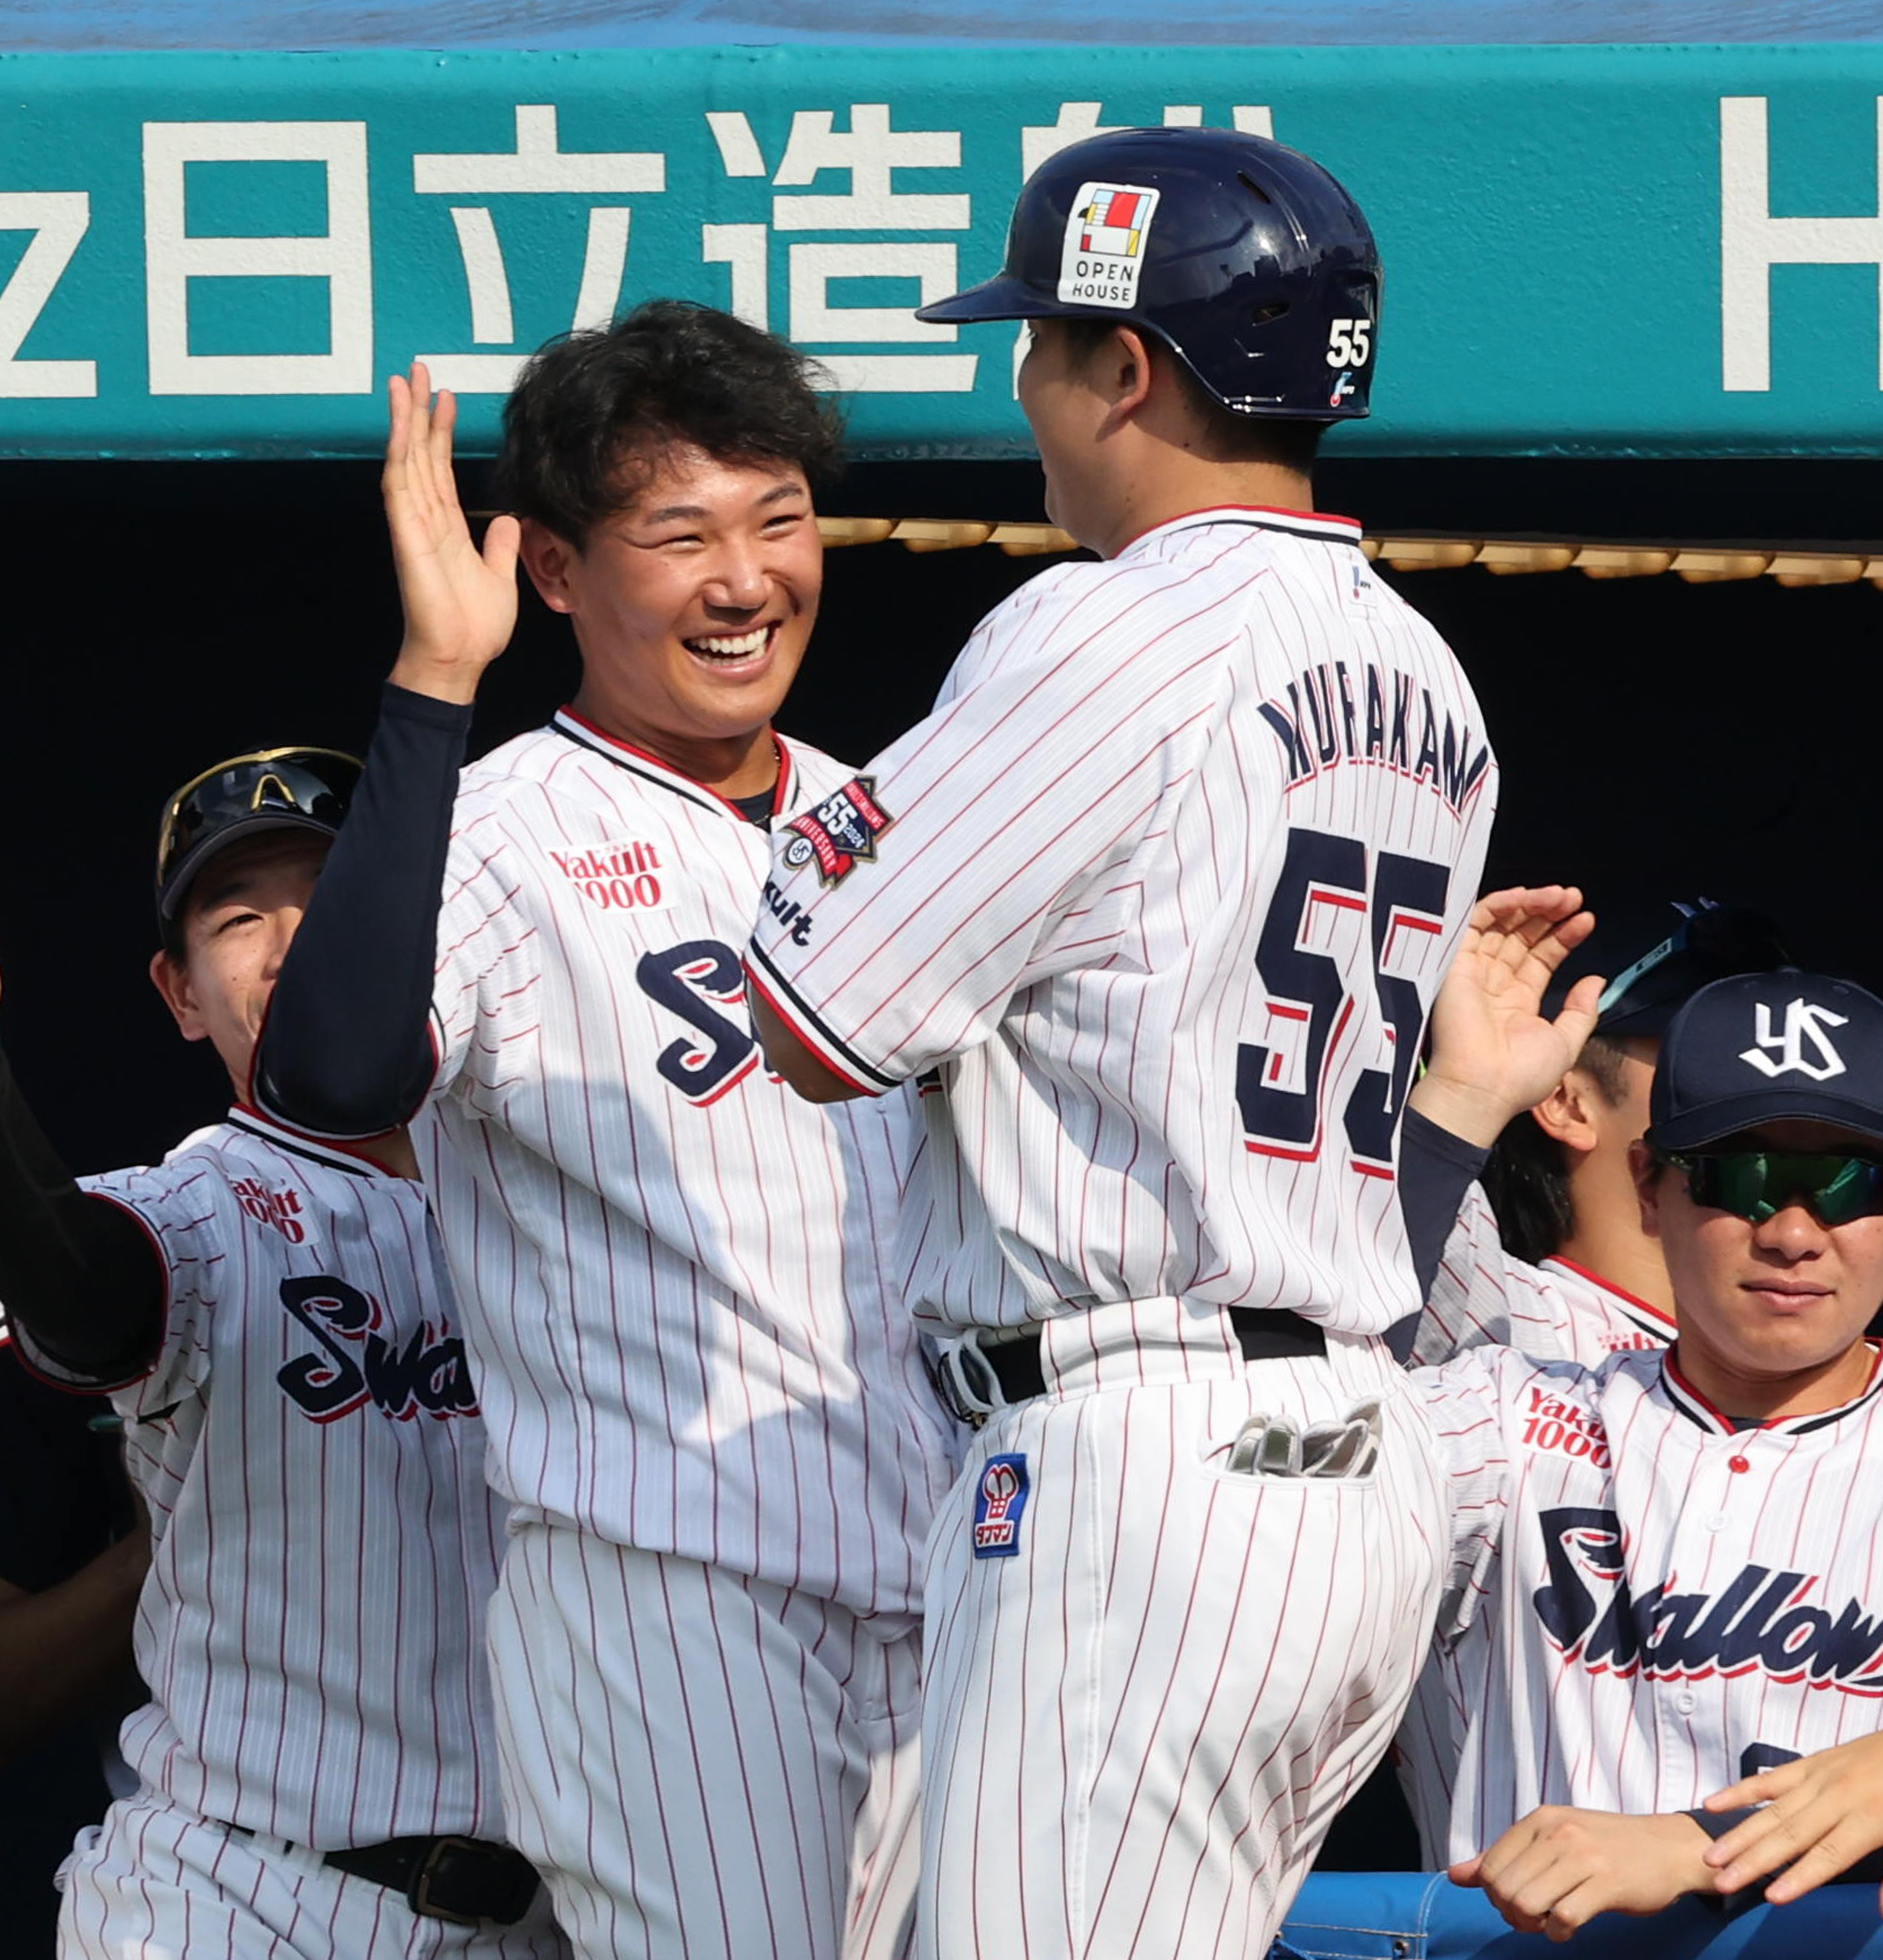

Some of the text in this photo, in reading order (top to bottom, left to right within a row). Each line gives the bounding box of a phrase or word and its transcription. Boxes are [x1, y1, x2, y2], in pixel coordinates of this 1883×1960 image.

[142, 102, 1274, 400] 日立造
[1076, 260, 1134, 282] OPEN
[1072, 283, 1131, 301] HOUSE
[1326, 319, 1371, 368] 55
[818, 792, 858, 836] 55
[844, 824, 865, 848] 2024
[549, 841, 663, 879] Yakult
[1235, 827, 1451, 1181] 55
[1522, 1417, 1612, 1468] 1000
[976, 1523, 1012, 1545] タフマン
